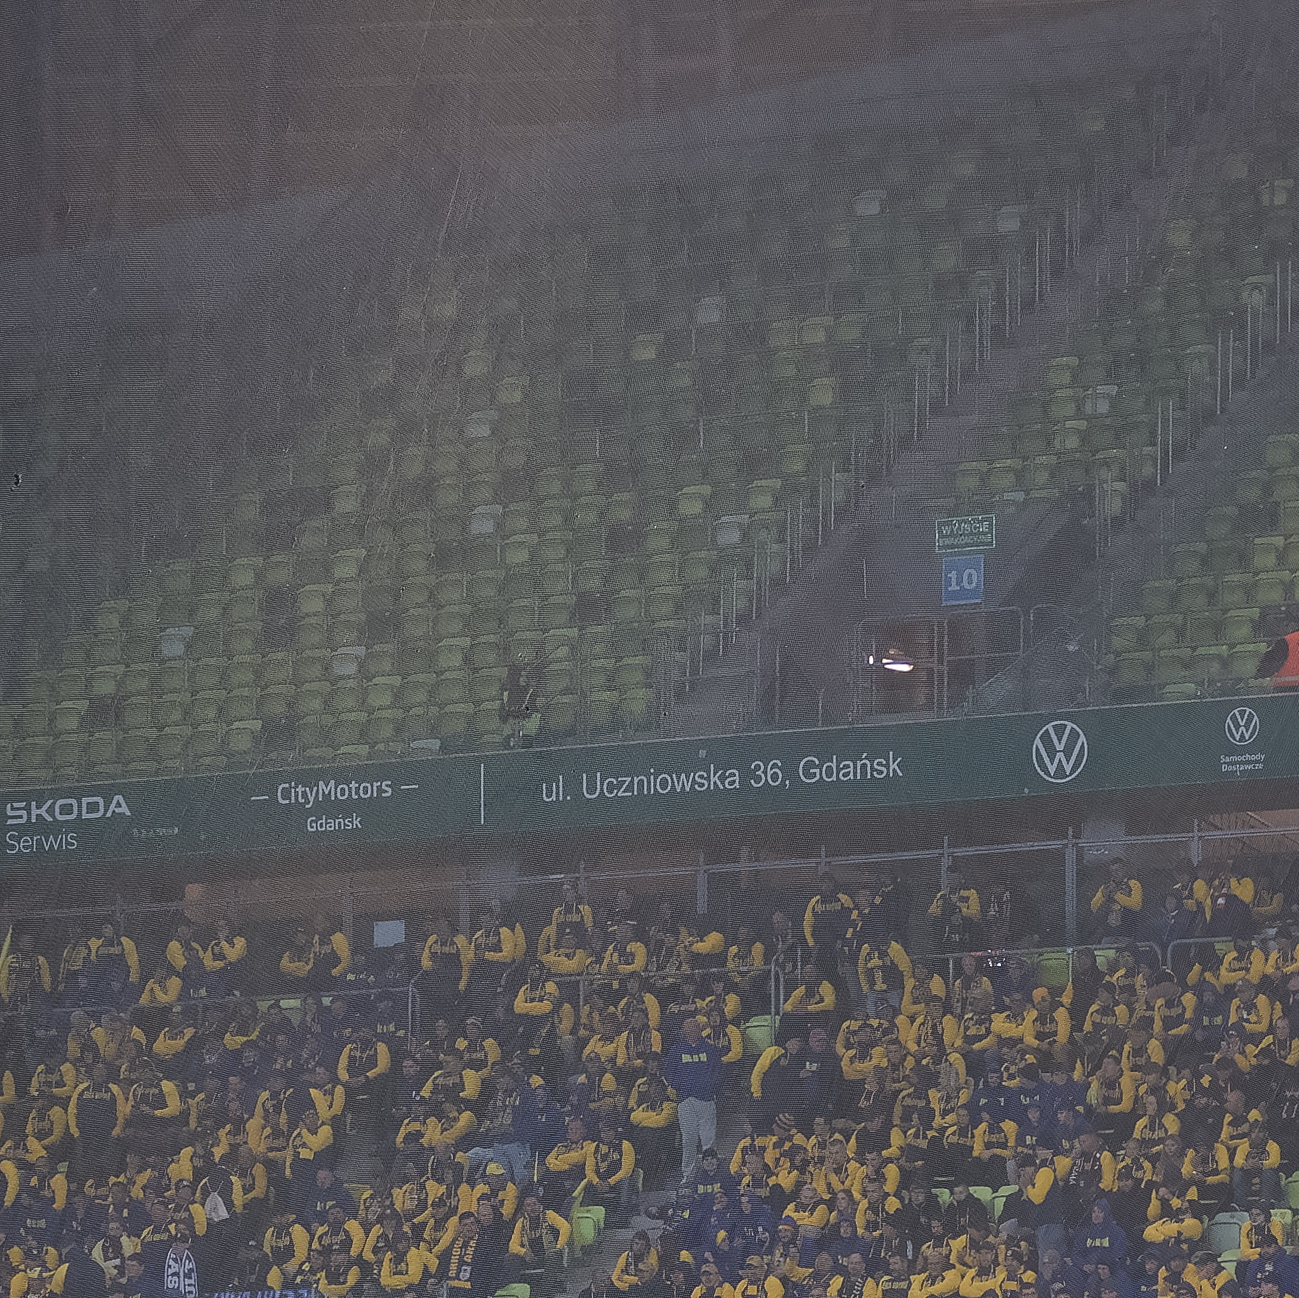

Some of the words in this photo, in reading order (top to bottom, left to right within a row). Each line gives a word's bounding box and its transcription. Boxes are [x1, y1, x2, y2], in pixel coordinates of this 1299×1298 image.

[948, 569, 977, 591] 10
[1220, 752, 1265, 763] Samochody
[541, 775, 571, 801] ul.
[582, 762, 739, 799] Uczniowska
[750, 759, 790, 789] 36,
[798, 751, 903, 784] Gdańsk
[277, 780, 392, 808] CityMotors
[307, 813, 362, 831] Gdańsk
[6, 828, 77, 853] Serwis
